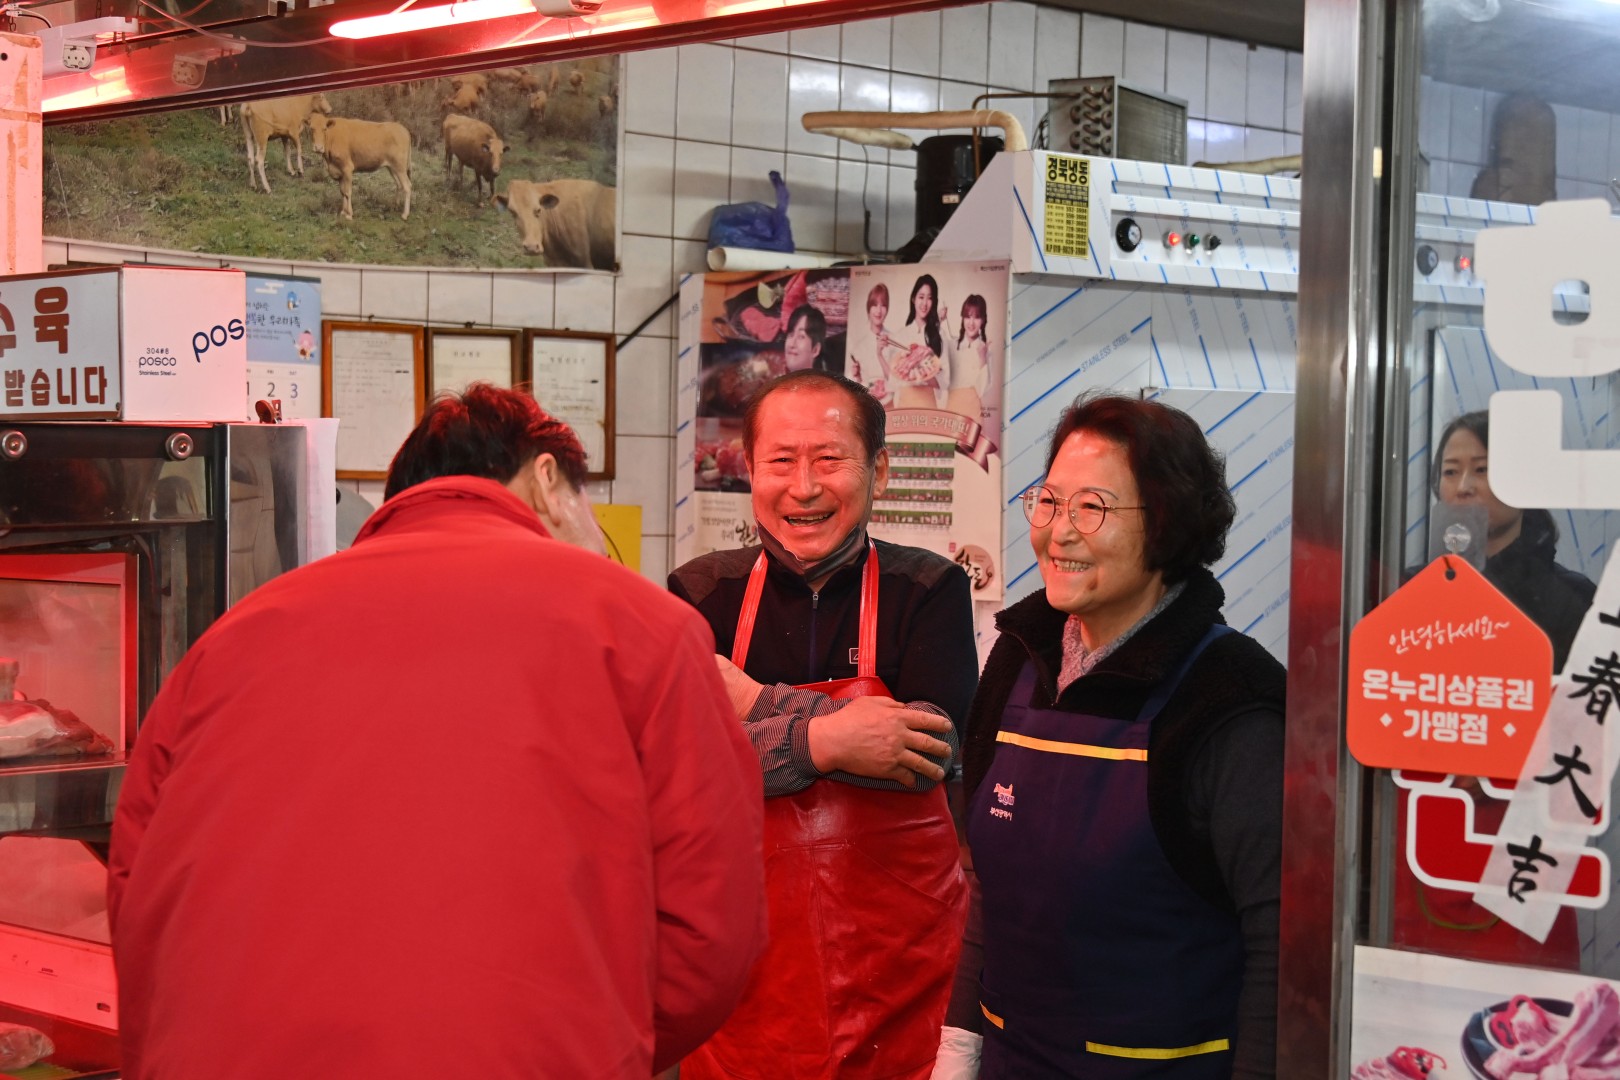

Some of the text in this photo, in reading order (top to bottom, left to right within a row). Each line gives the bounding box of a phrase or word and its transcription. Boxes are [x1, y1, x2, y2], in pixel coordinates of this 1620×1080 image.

[1048, 157, 1088, 185] 경북냉동
[138, 356, 177, 369] posco
[1081, 348, 1111, 372] STAINLESS
[1112, 333, 1131, 350] STEEL
[4, 366, 108, 407] 받습니다
[267, 382, 276, 398] 2
[290, 383, 299, 399] 3
[892, 415, 909, 428] 밥상
[912, 415, 928, 427] 위의
[1361, 669, 1534, 711] 온누리상품권
[1402, 709, 1488, 745] 가맹점
[1506, 611, 1620, 903] 春大吉
